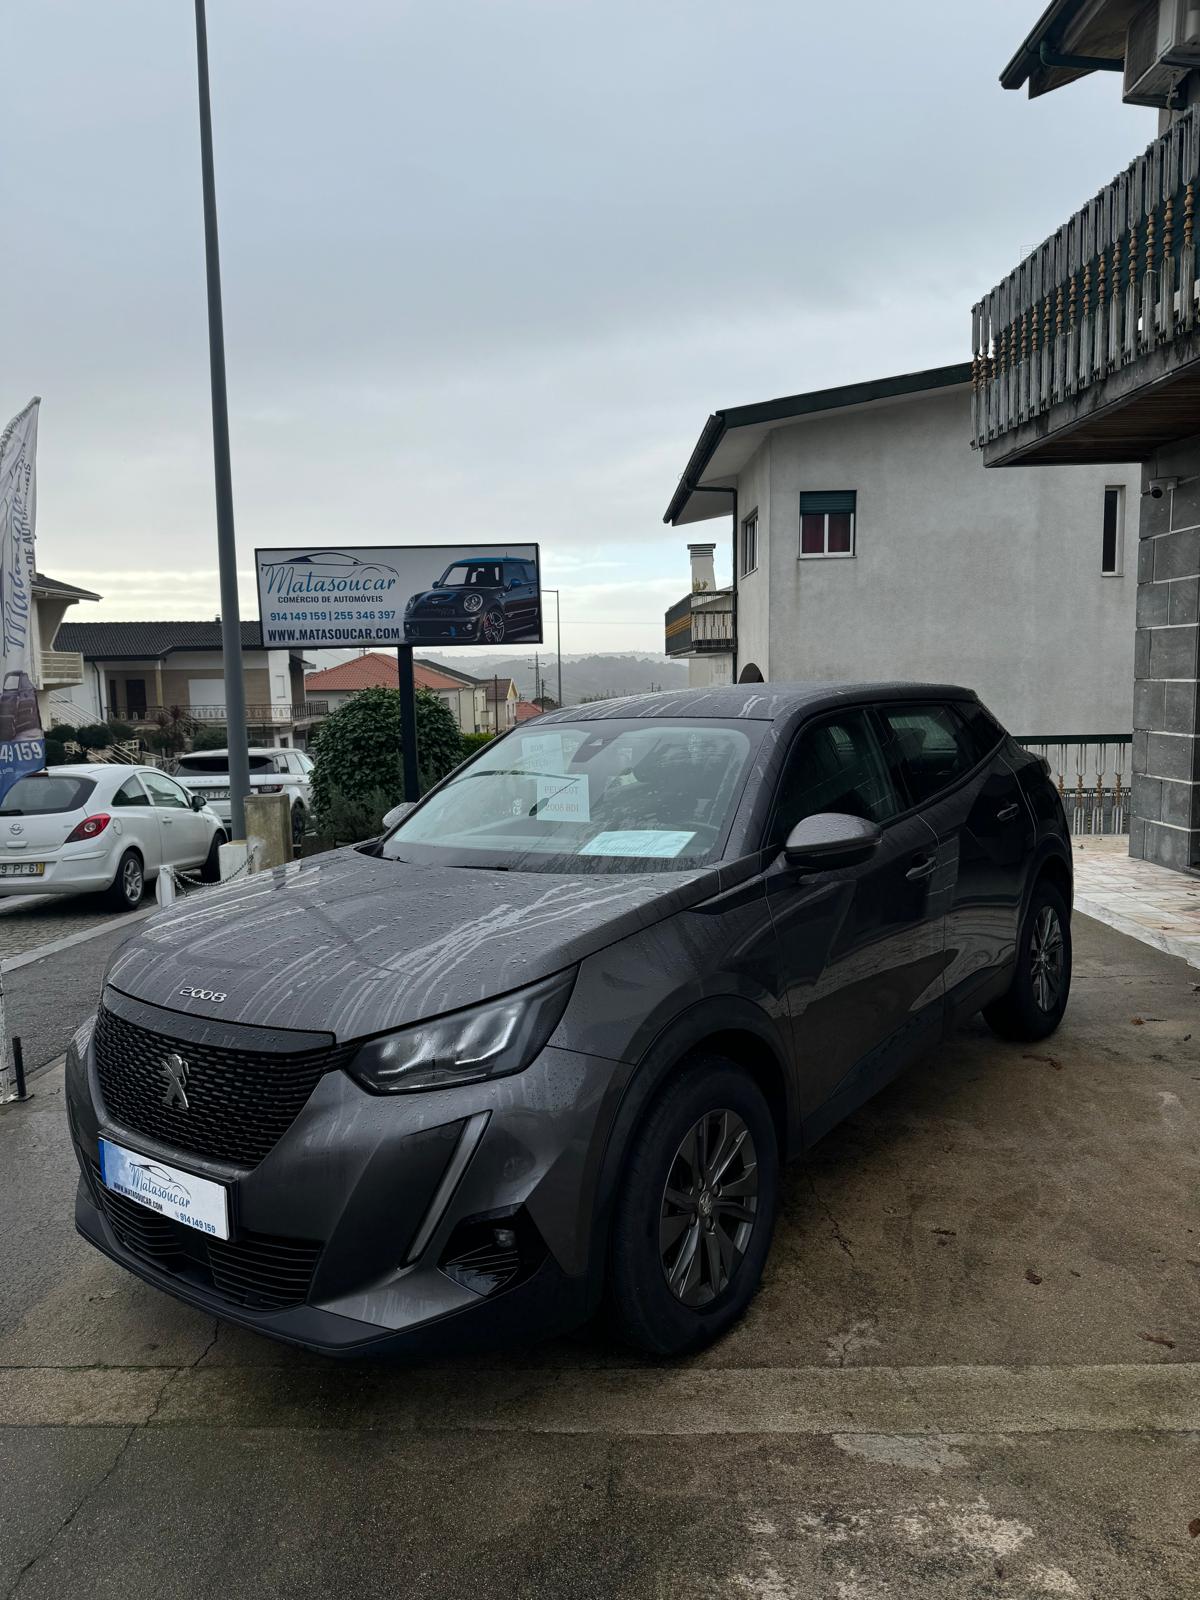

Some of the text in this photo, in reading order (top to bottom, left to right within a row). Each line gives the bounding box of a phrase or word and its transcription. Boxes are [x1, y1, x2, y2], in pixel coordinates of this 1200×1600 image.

[261, 565, 396, 596] Matasoucar
[278, 594, 383, 604] COMÉRCIO DE AUTOMÓVEIS
[270, 612, 288, 621] 914
[290, 612, 307, 621] 149
[310, 611, 327, 620] 159
[334, 611, 353, 620] 255
[356, 610, 375, 620] 346
[378, 610, 396, 620] 397
[268, 628, 400, 641] WWW.MATASOUCAR.COM
[14, 742, 43, 761] 159
[179, 986, 228, 1003] 2008
[129, 1164, 191, 1209] Matasoucar
[179, 1212, 216, 1234] 914 149 159
